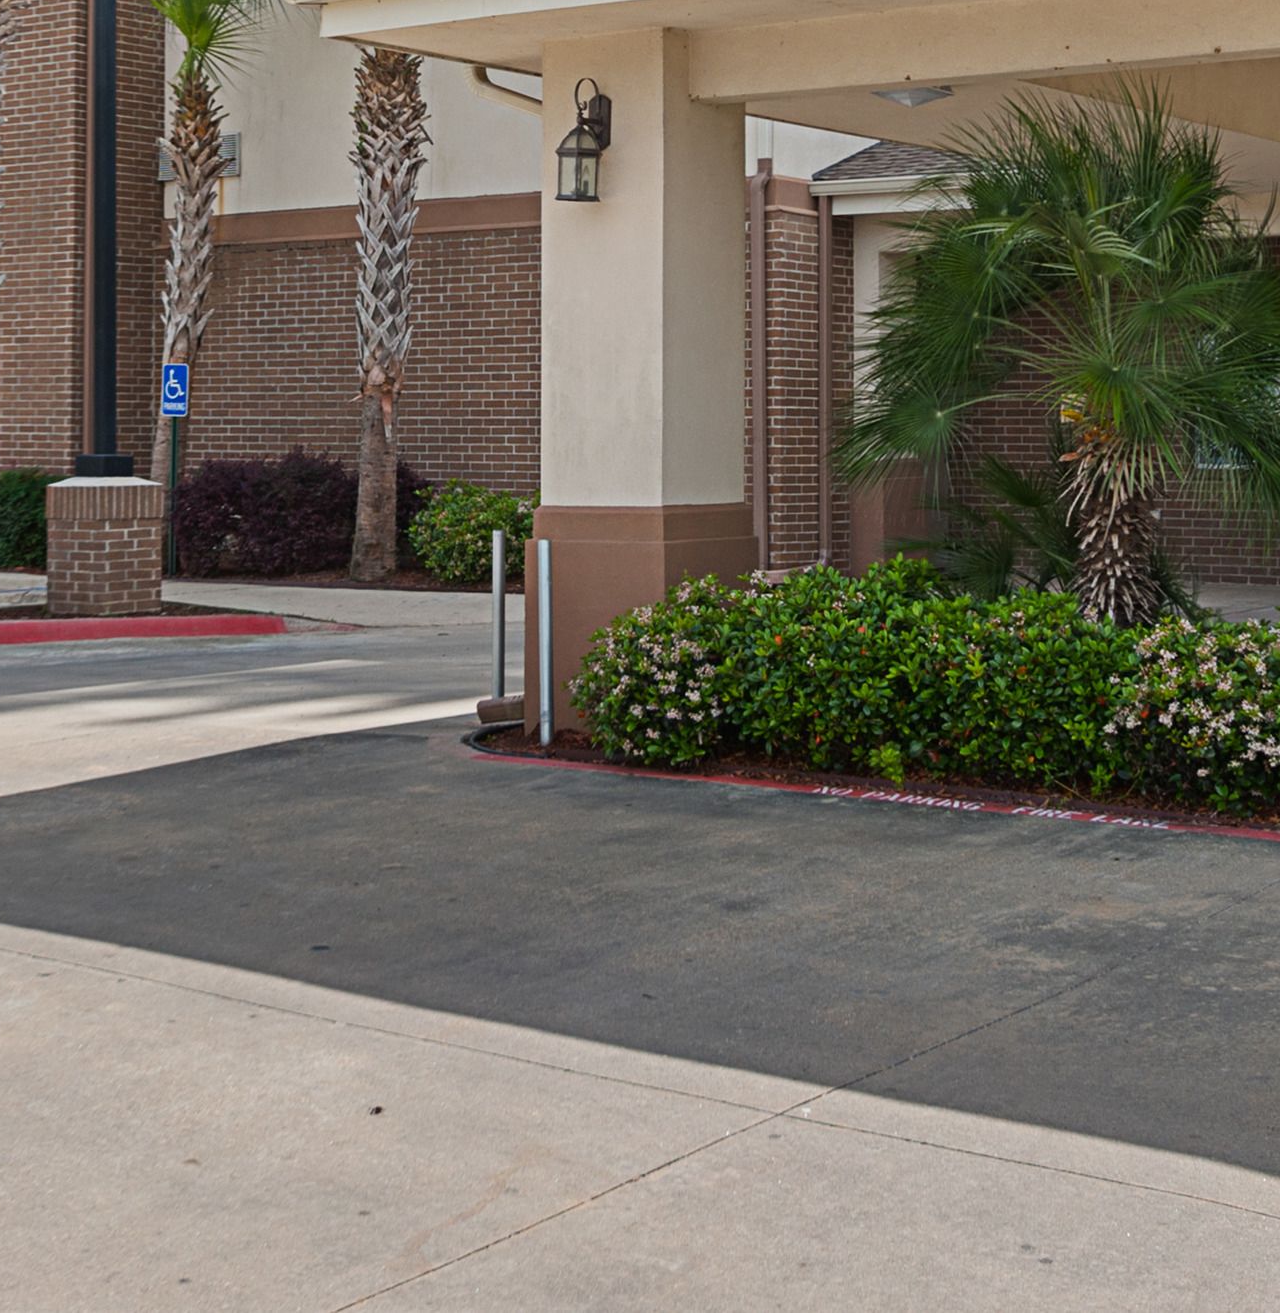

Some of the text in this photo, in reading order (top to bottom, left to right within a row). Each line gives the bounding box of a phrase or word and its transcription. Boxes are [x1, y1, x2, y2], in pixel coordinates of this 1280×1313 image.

[811, 785, 853, 796] NO
[860, 790, 986, 811] PARKING
[1010, 806, 1083, 821] FIRE
